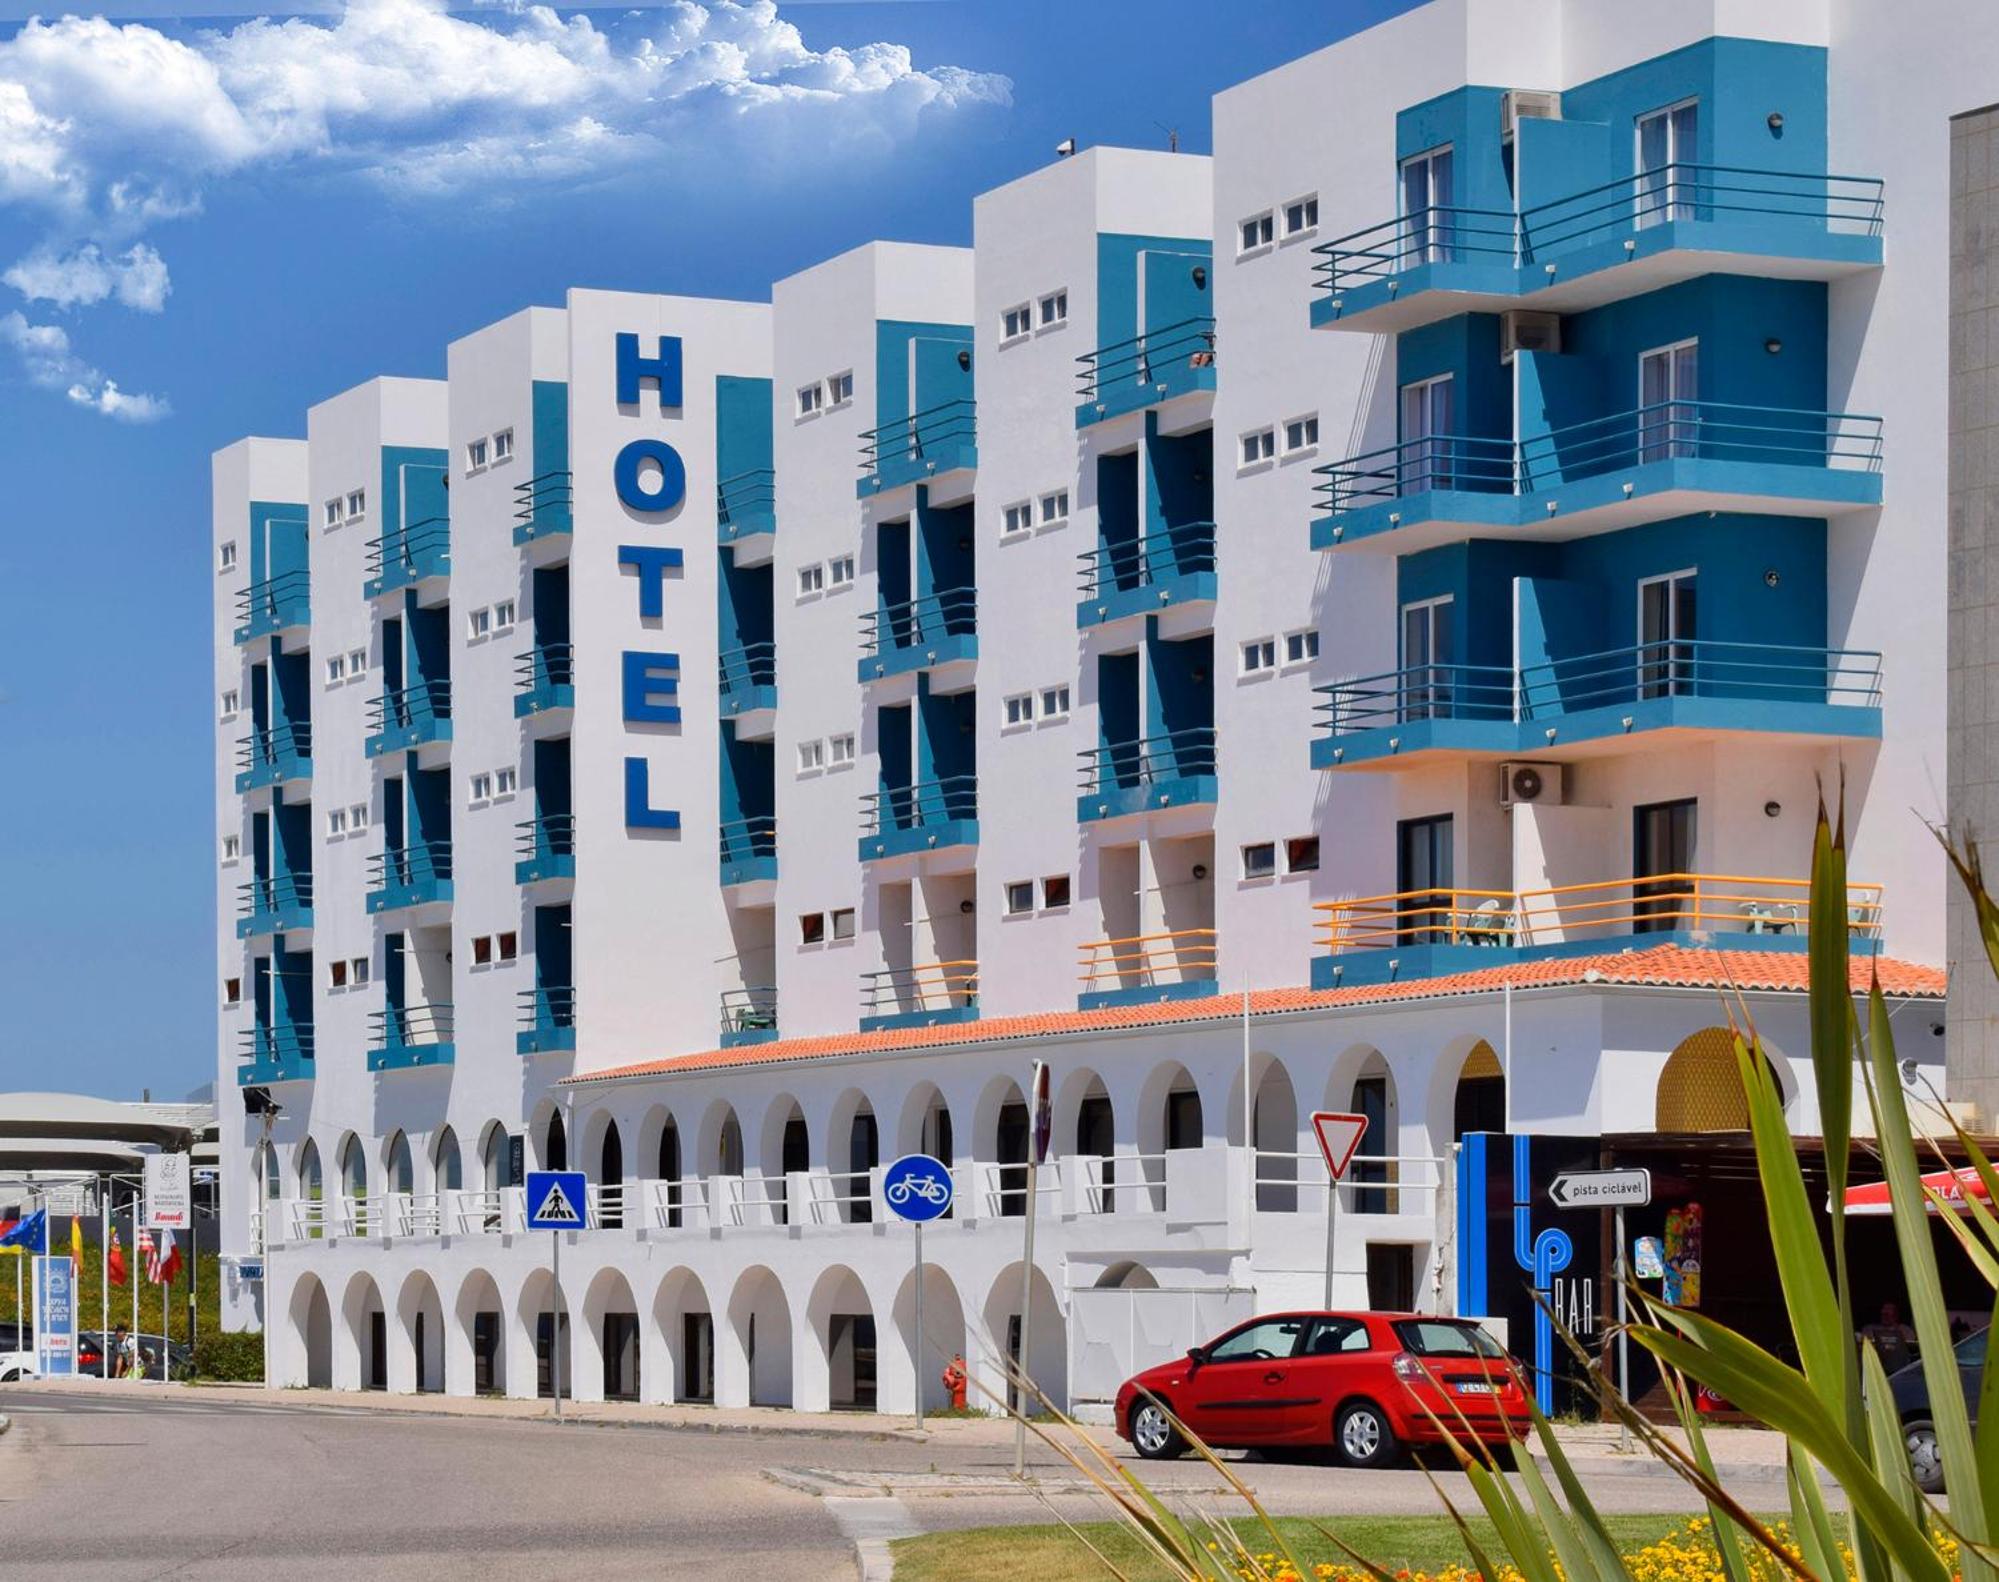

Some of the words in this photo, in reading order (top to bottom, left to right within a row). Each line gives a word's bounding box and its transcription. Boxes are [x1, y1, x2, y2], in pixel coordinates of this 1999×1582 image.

[614, 332, 686, 829] HOTEL
[1573, 1183, 1599, 1197] pista
[1602, 1181, 1642, 1194] ciclável
[1555, 1278, 1592, 1335] BAR
